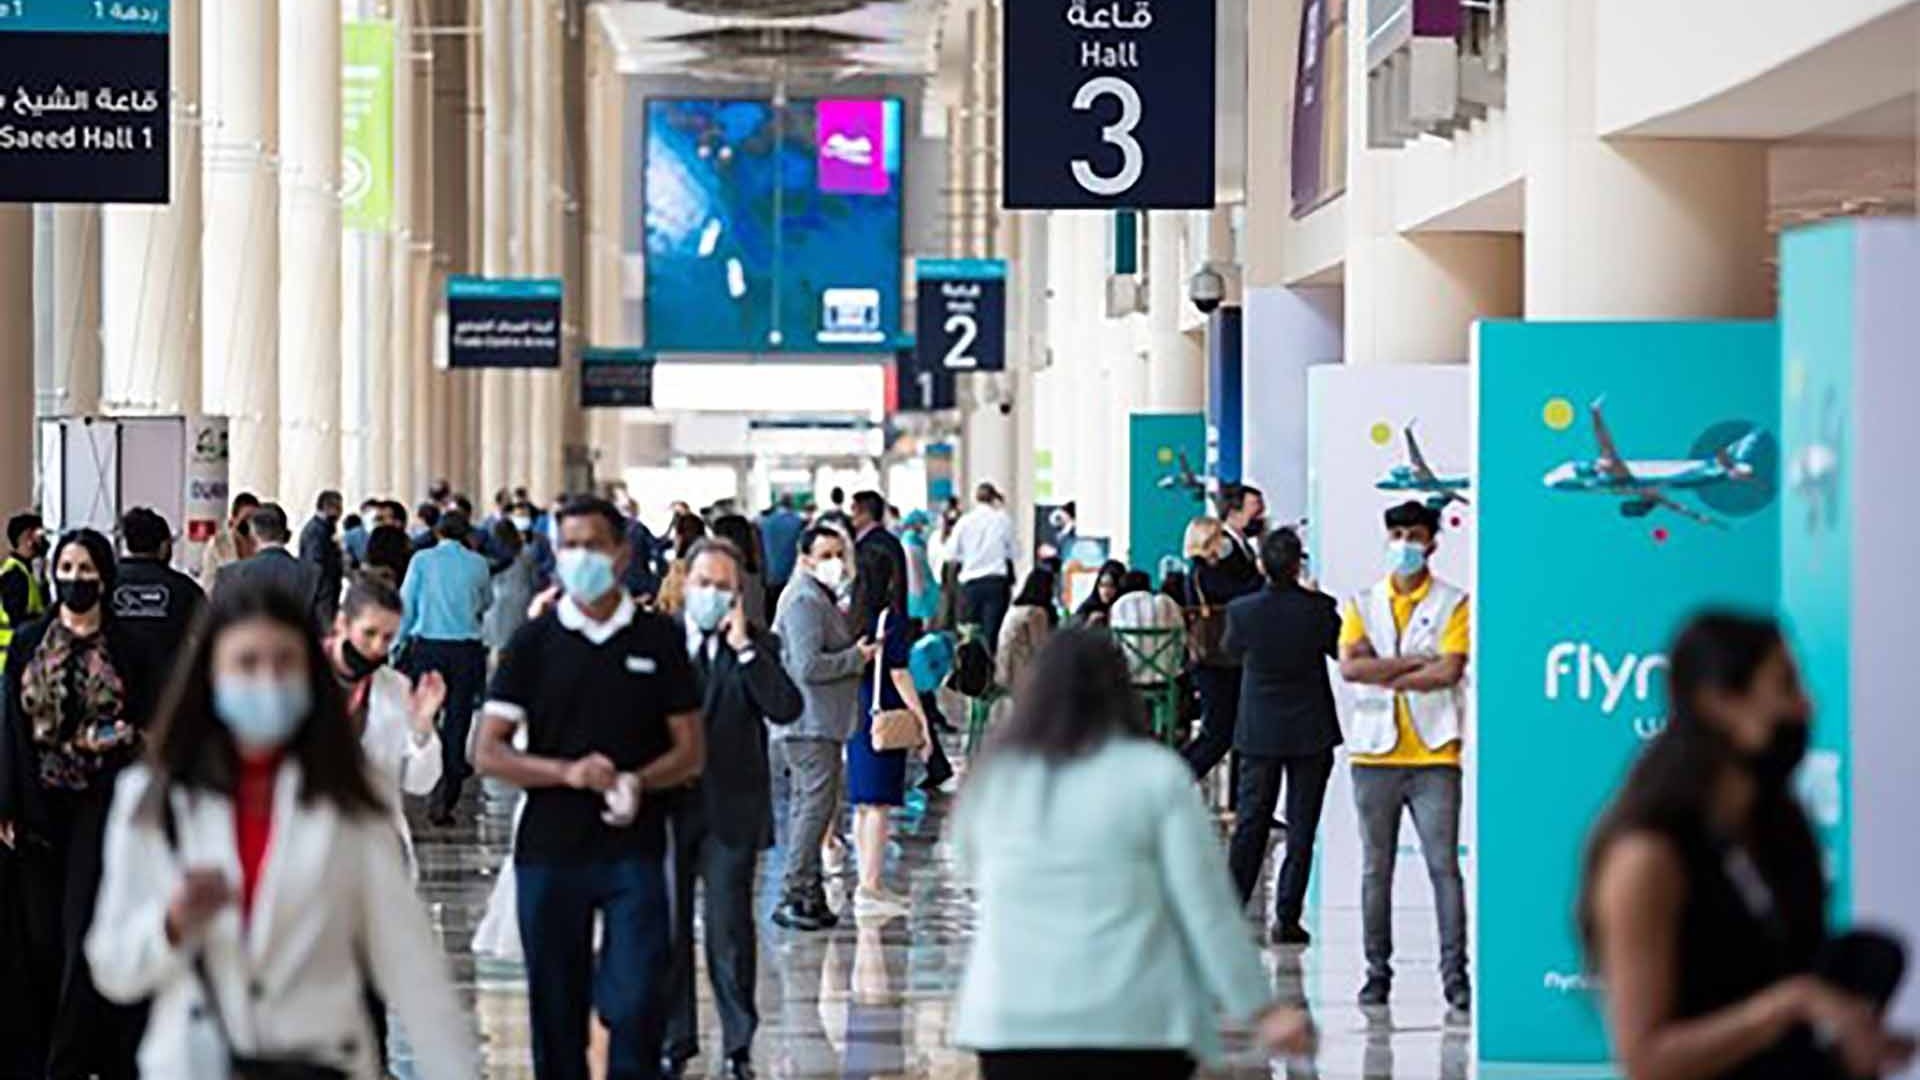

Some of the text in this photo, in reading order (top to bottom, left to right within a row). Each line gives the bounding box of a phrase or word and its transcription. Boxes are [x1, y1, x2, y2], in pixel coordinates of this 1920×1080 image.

[1066, 0, 1153, 28] قاعة
[1081, 41, 1138, 67] Hall
[13, 84, 89, 117] الشيخ
[95, 86, 158, 112] قاعة
[0, 124, 152, 149] Saeed Hall 1
[1070, 76, 1145, 196] 3
[943, 314, 978, 369] 2
[916, 371, 933, 408] 1
